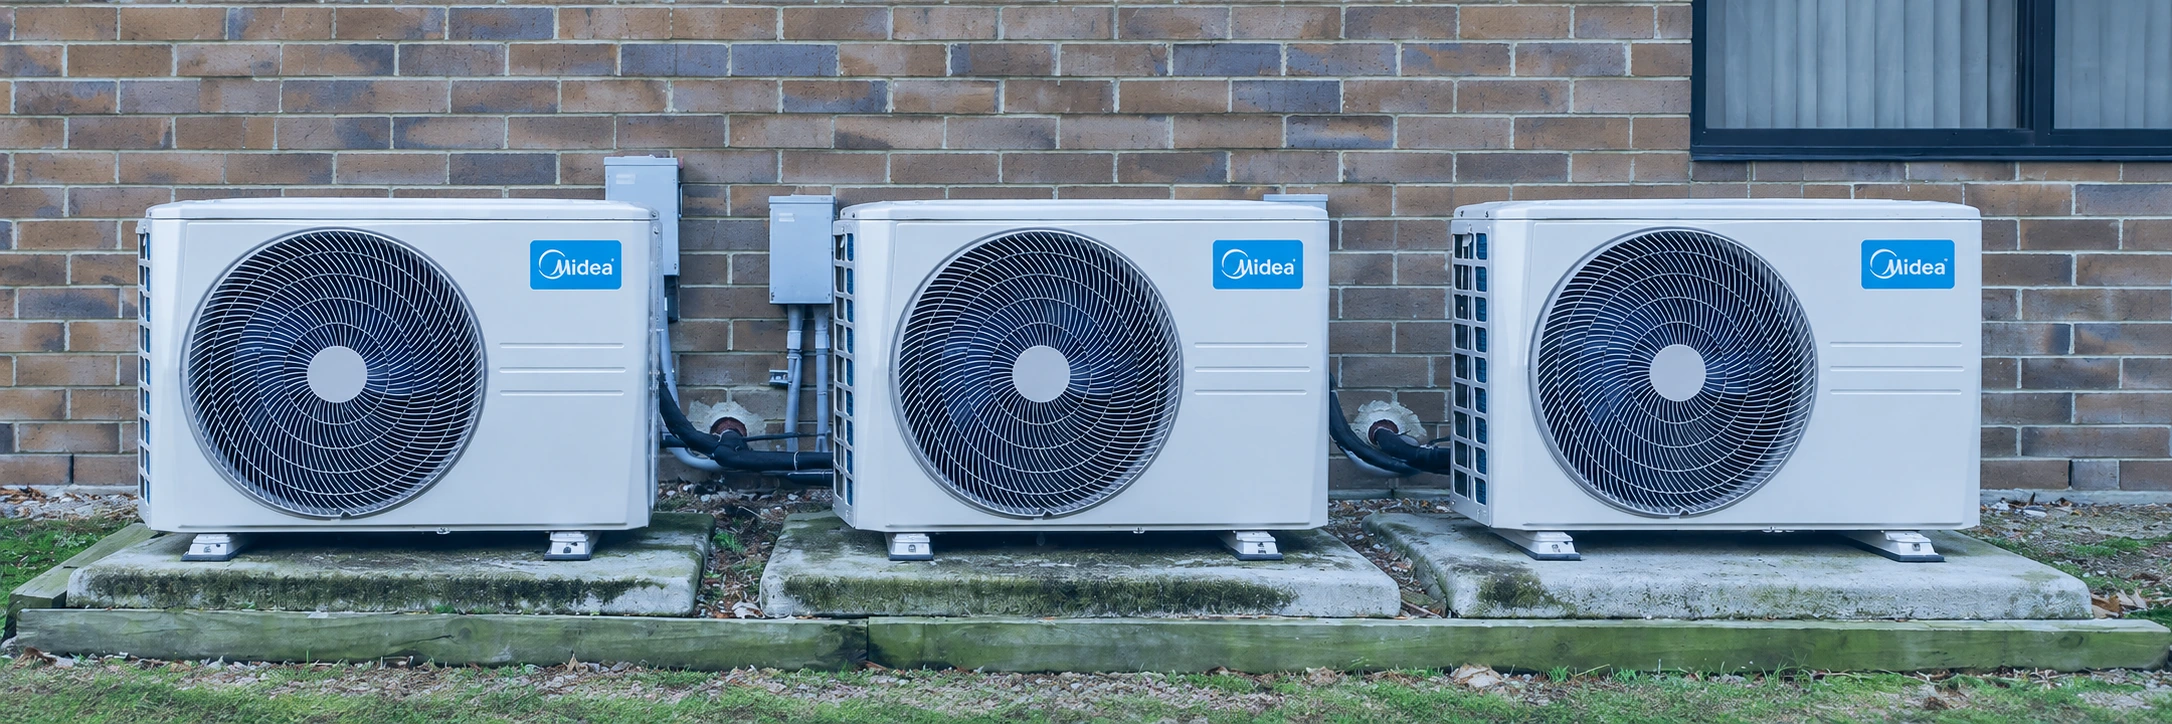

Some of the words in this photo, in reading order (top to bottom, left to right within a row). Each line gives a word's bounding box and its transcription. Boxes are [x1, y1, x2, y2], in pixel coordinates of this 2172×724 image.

[538, 257, 614, 280] Midea
[1221, 257, 1295, 280] Midea
[1869, 257, 1947, 280] Midea
